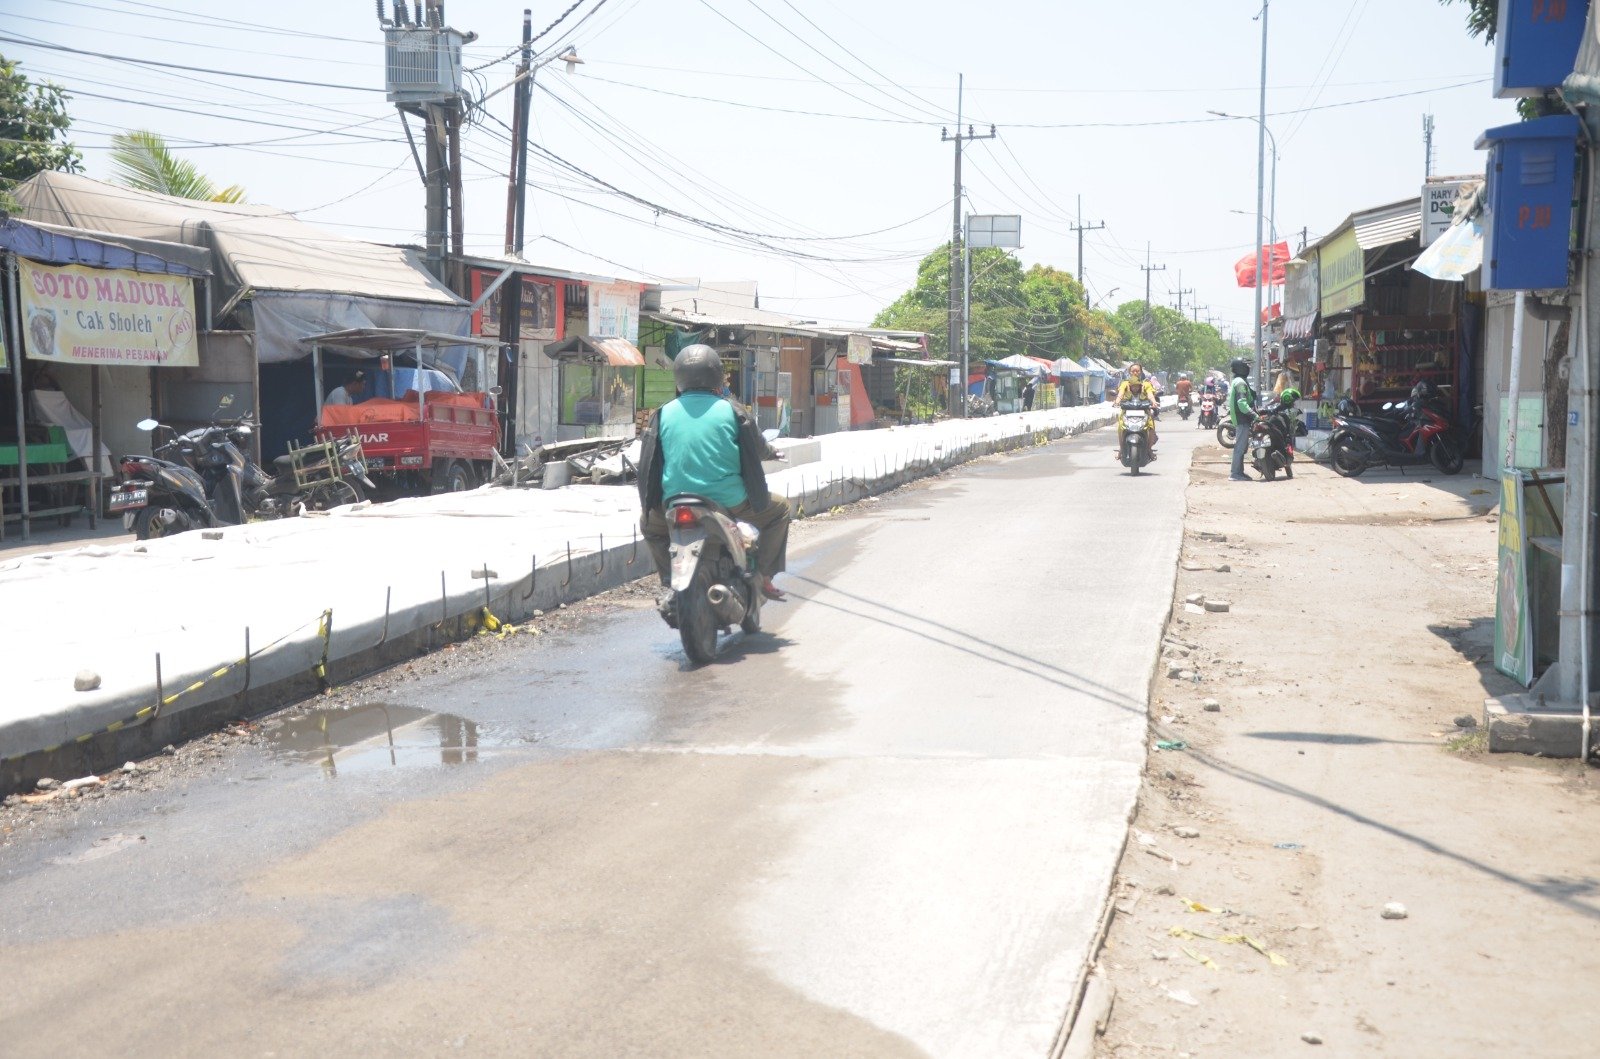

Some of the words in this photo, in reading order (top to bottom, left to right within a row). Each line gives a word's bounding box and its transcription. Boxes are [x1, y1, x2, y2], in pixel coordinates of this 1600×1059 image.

[1431, 190, 1452, 199] HARY
[1517, 205, 1552, 230] PJU
[32, 270, 89, 300] SOTO
[95, 277, 184, 308] MADURA
[72, 346, 123, 360] MENERIMA
[126, 348, 168, 361] PESANAN
